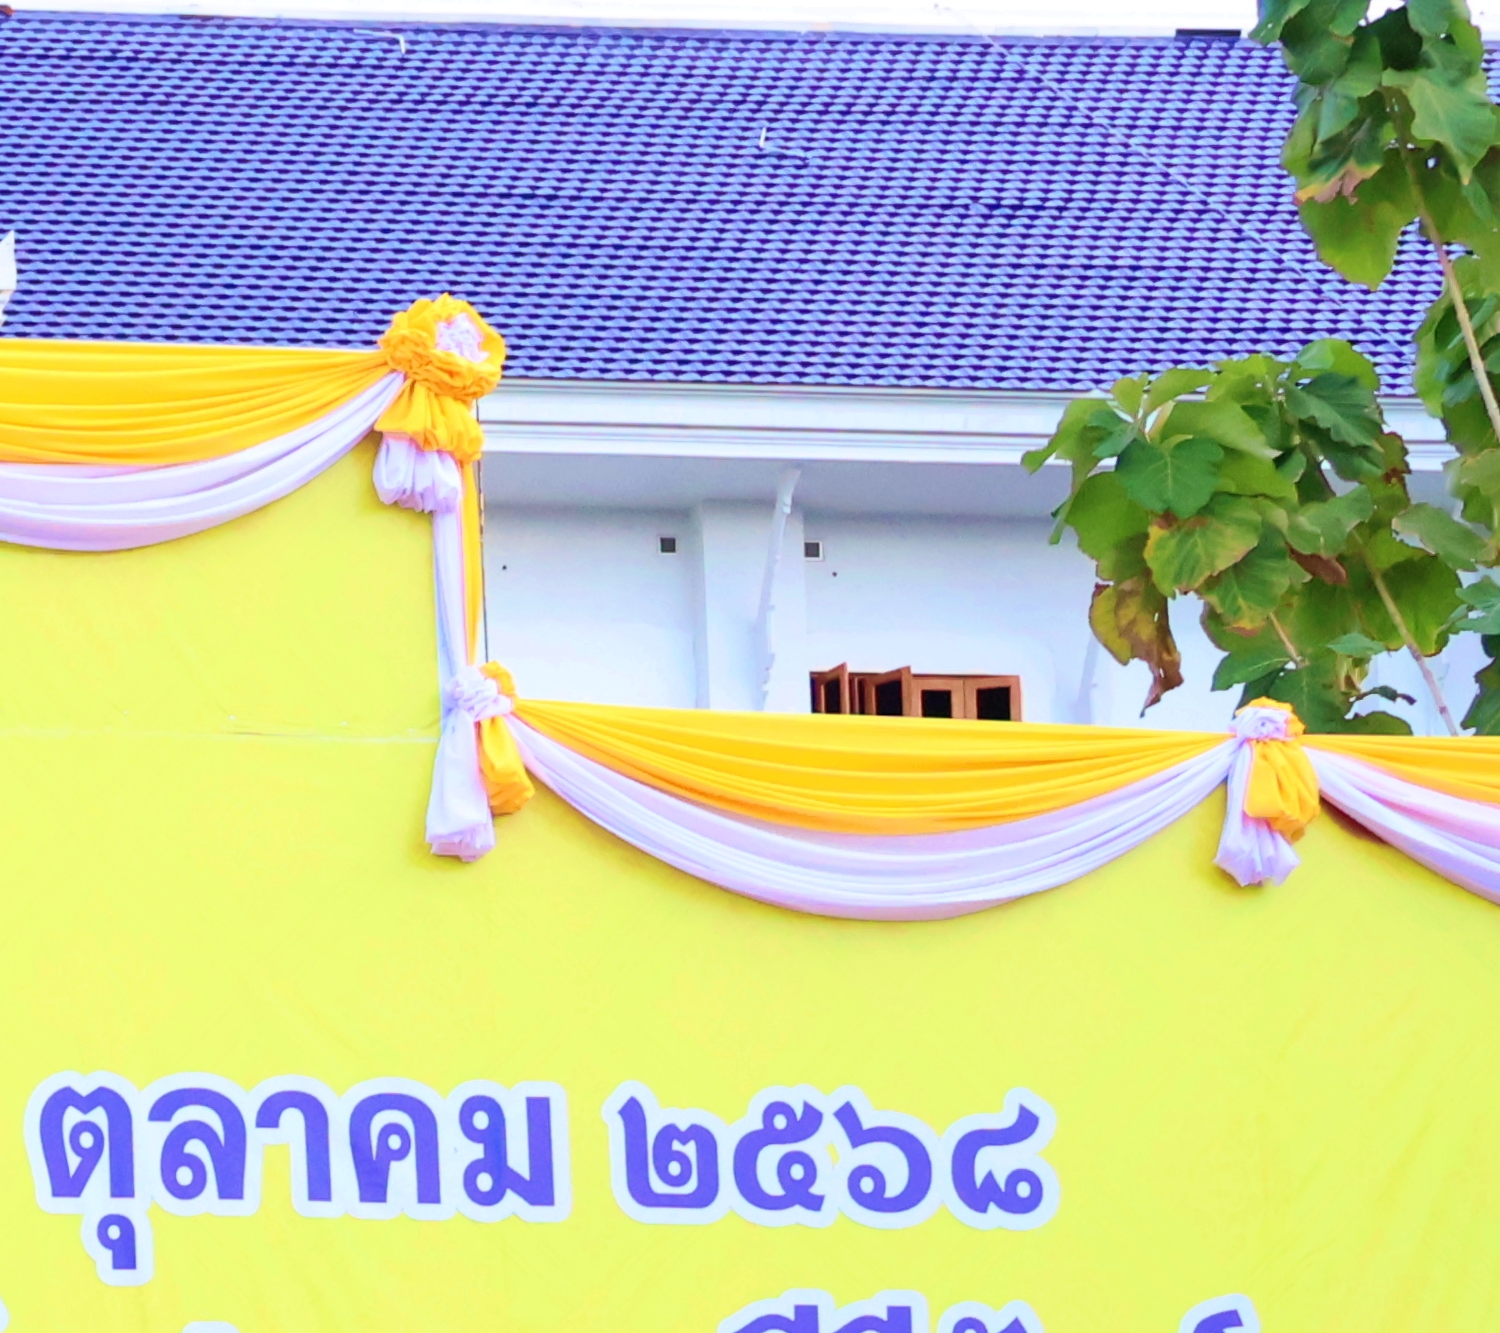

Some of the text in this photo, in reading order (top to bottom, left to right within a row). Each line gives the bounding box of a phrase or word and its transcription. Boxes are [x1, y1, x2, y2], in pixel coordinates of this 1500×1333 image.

[38, 1084, 557, 1272] ตุลาคม
[616, 1094, 1045, 1216] ๒๕๖๘
